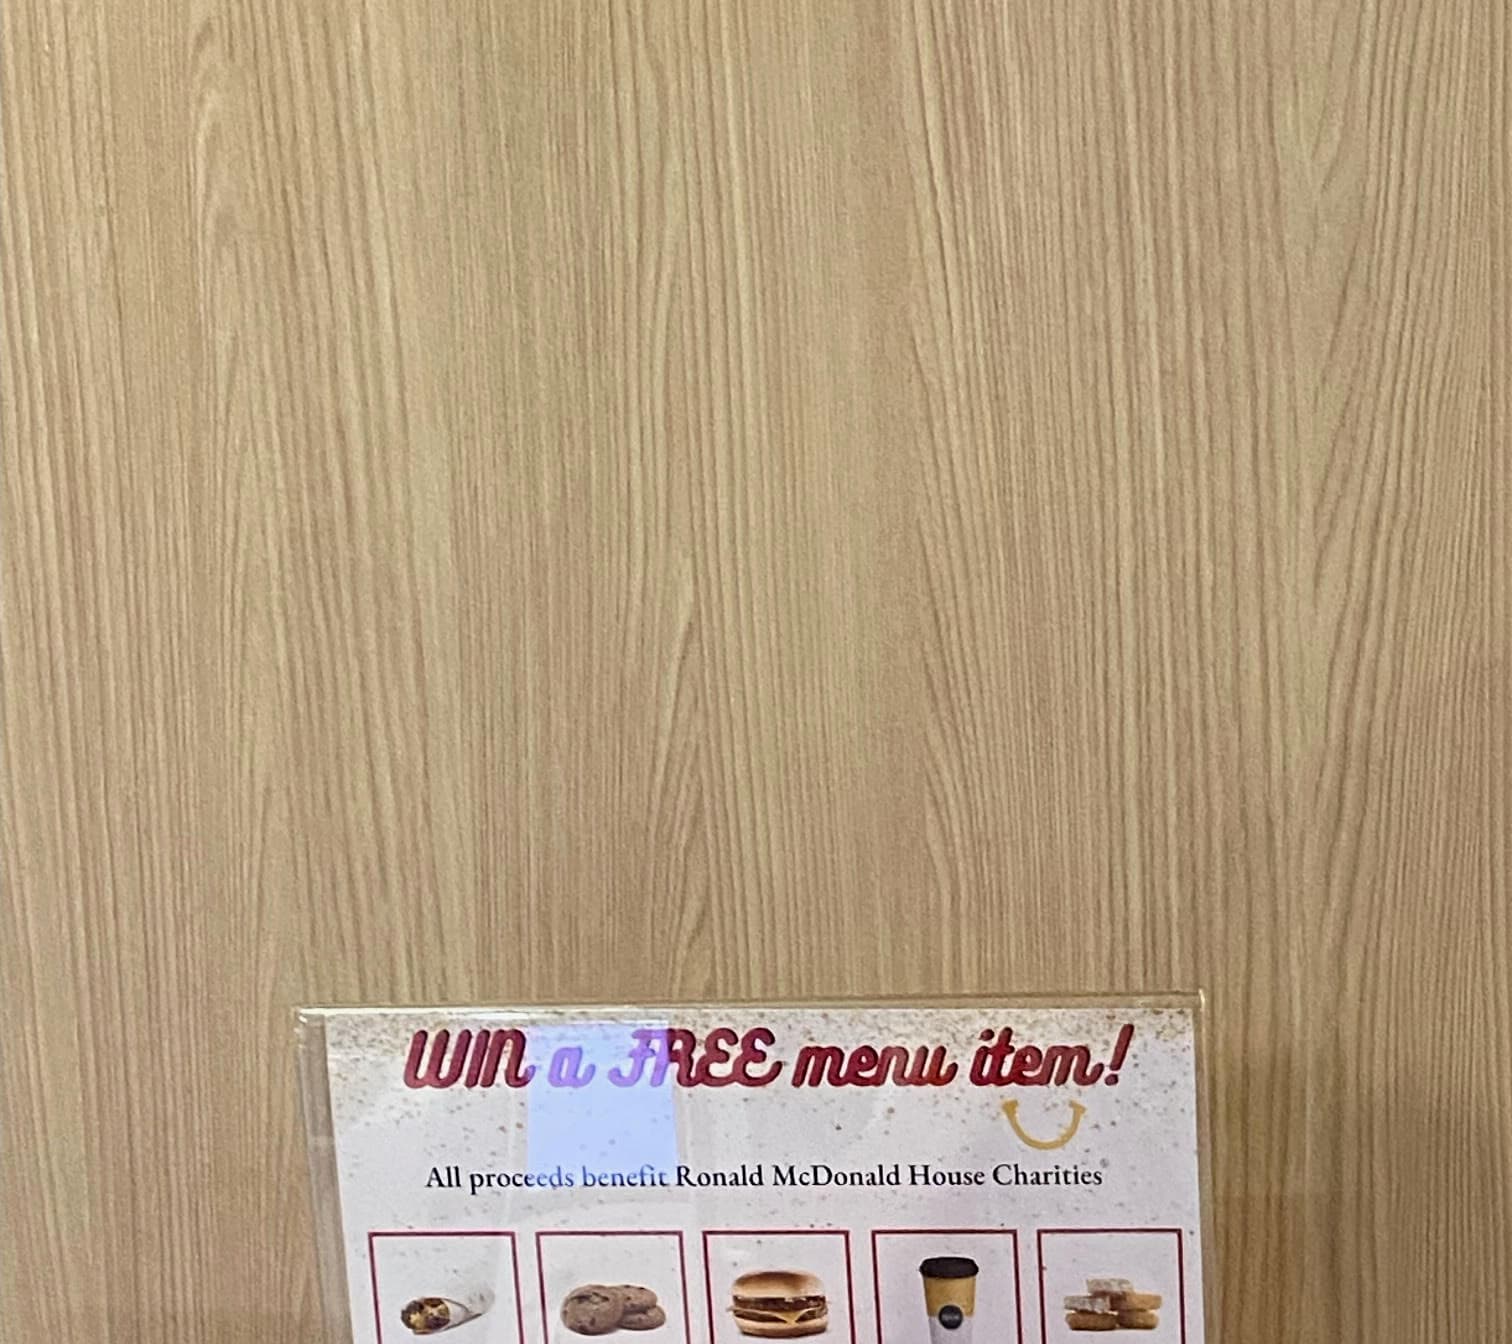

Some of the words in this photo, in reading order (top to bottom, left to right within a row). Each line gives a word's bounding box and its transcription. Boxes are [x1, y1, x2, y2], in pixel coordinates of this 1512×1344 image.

[403, 1028, 536, 1088] WIN
[546, 1046, 596, 1088] a
[607, 1027, 783, 1087] FREE
[792, 1045, 958, 1087] menu
[969, 1023, 1134, 1086] item!
[425, 1165, 461, 1188] All
[469, 1166, 574, 1195] proceeds
[582, 1164, 668, 1188] benefit
[675, 1164, 764, 1187] Ronald
[772, 1163, 900, 1187] McDonald
[908, 1164, 985, 1186] House
